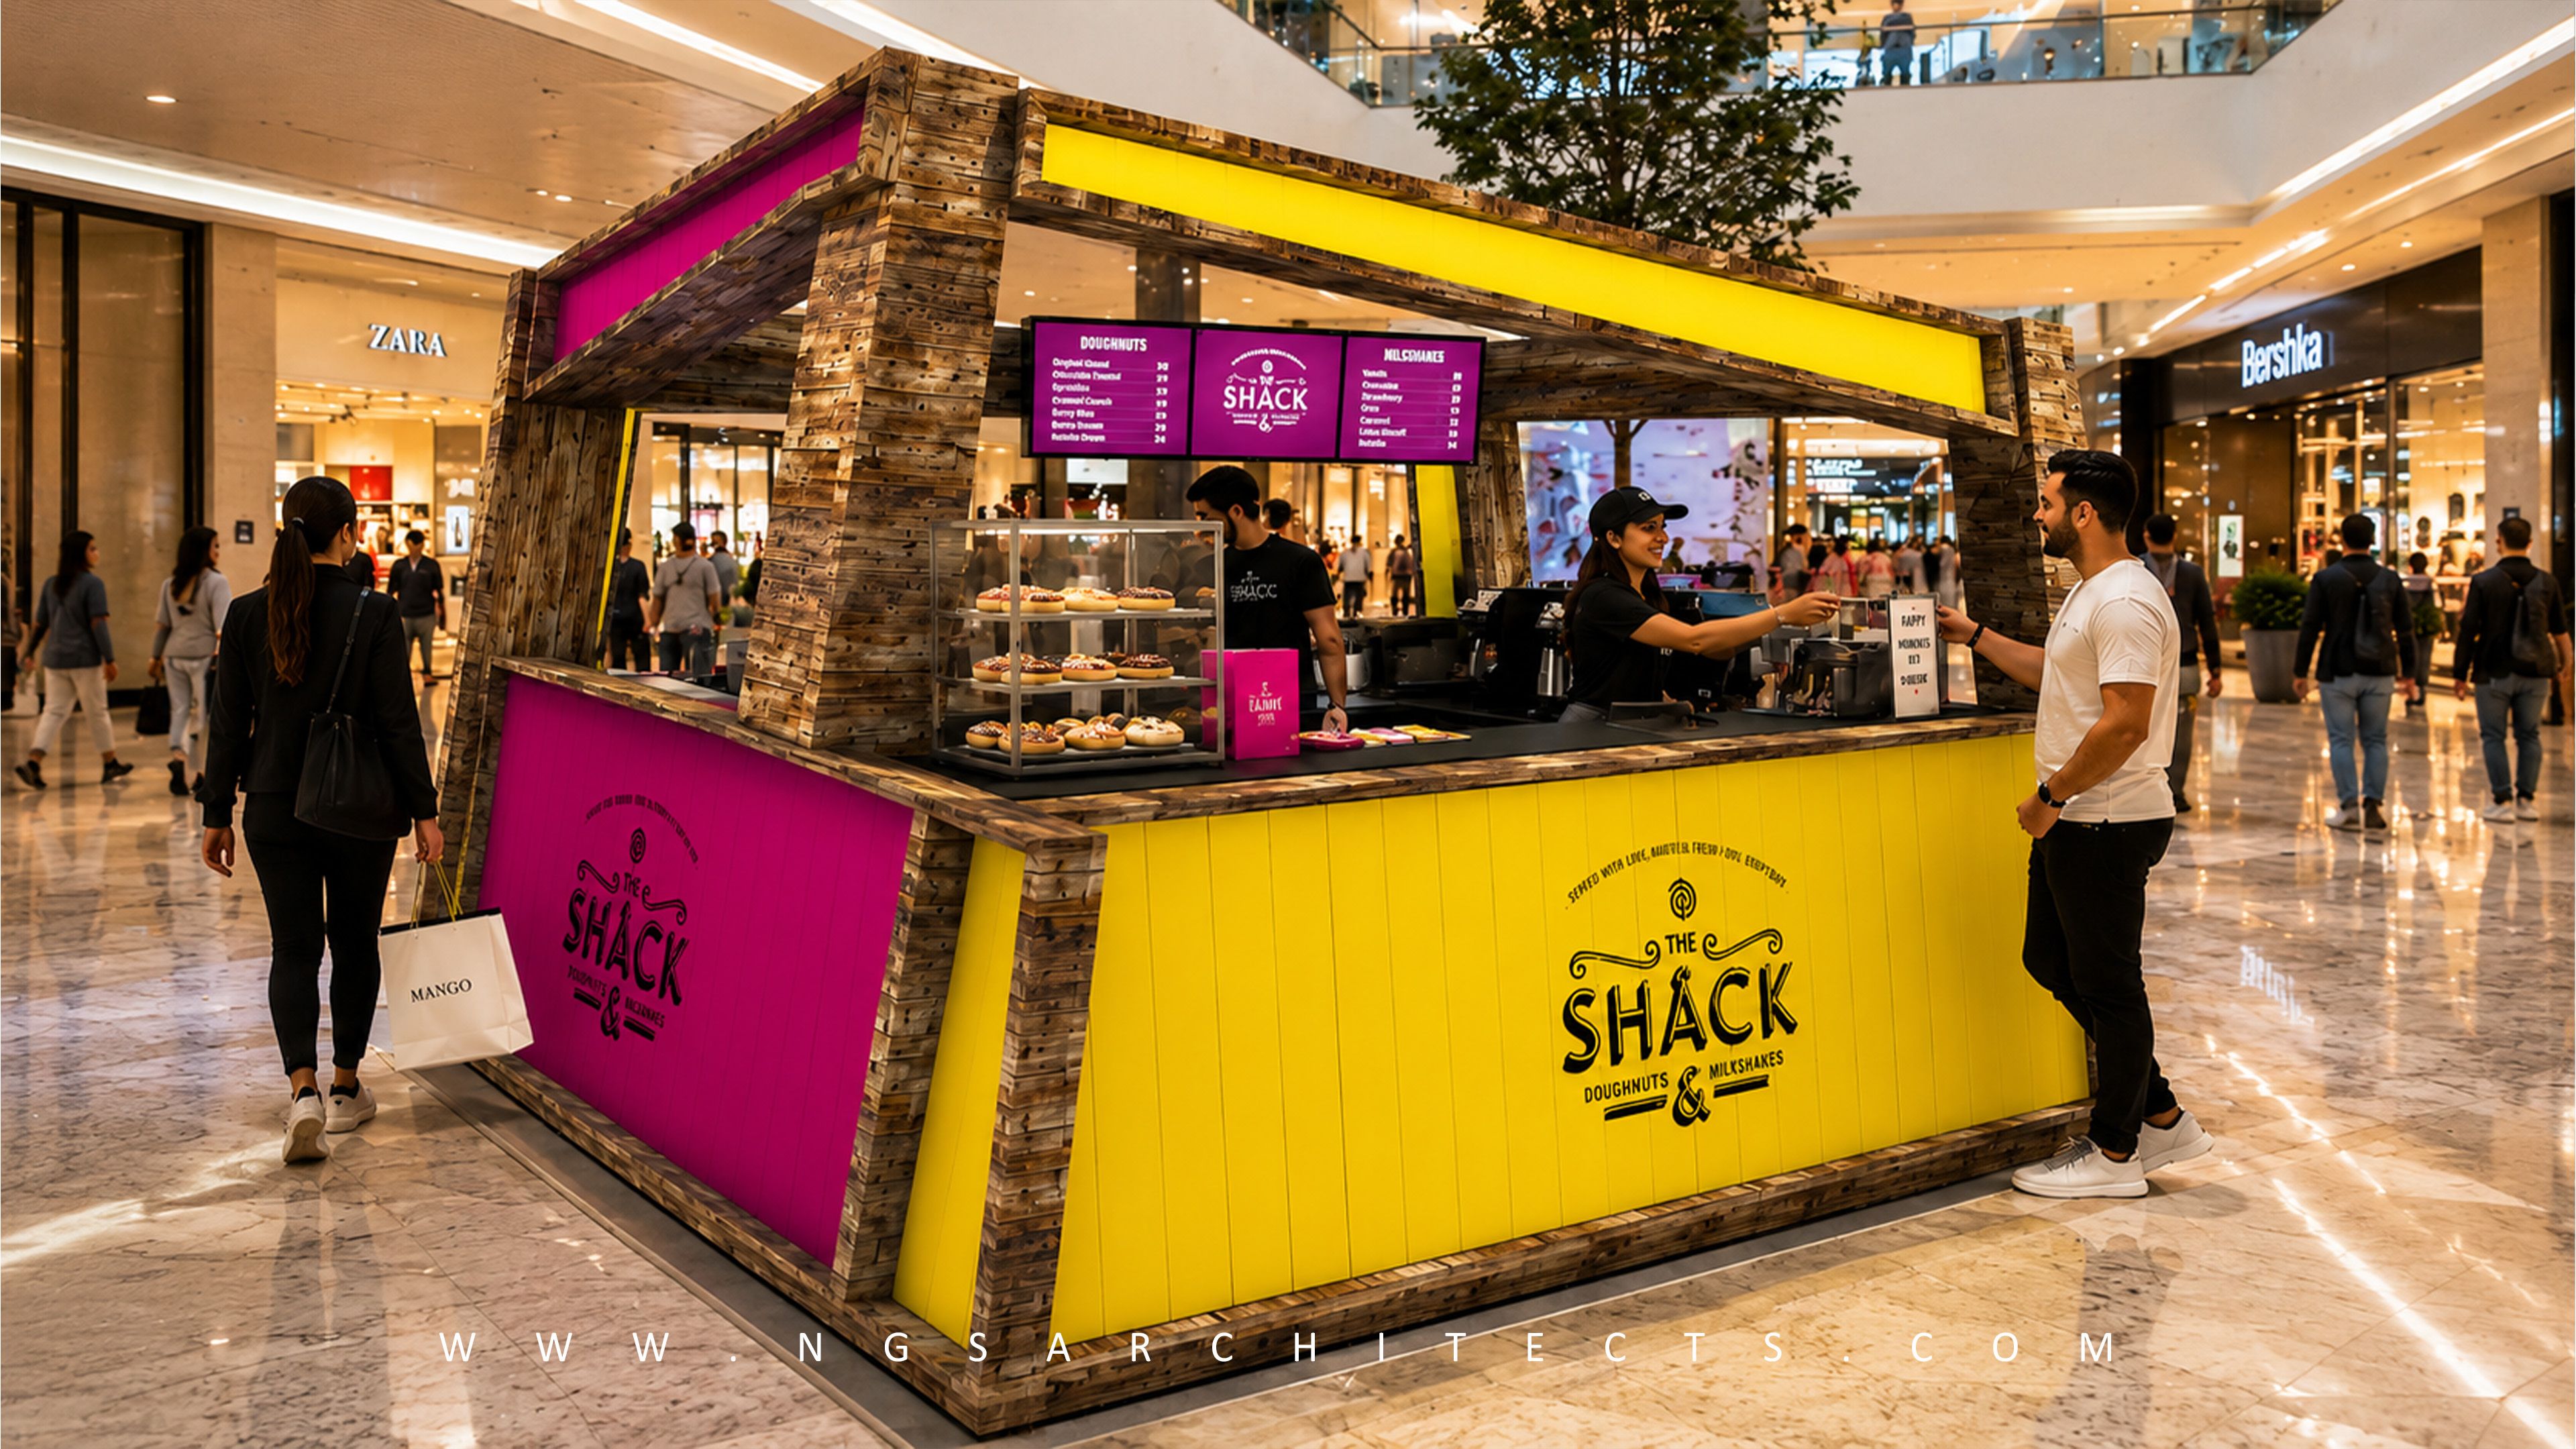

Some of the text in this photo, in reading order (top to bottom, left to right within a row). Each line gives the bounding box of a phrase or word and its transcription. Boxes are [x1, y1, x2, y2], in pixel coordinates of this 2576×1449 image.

[368, 323, 447, 357] ZARA
[1081, 336, 1147, 352] DOUGHNUTS
[2242, 323, 2323, 388] Bershka
[1223, 385, 1307, 411] SHACK
[563, 888, 690, 1006] SHACK
[1665, 932, 1697, 955] THE
[411, 978, 472, 1003] MANGO
[1562, 962, 1798, 1074] SHACK
[1585, 1050, 1784, 1127] DOUGHNUTS & MILKSHAKES
